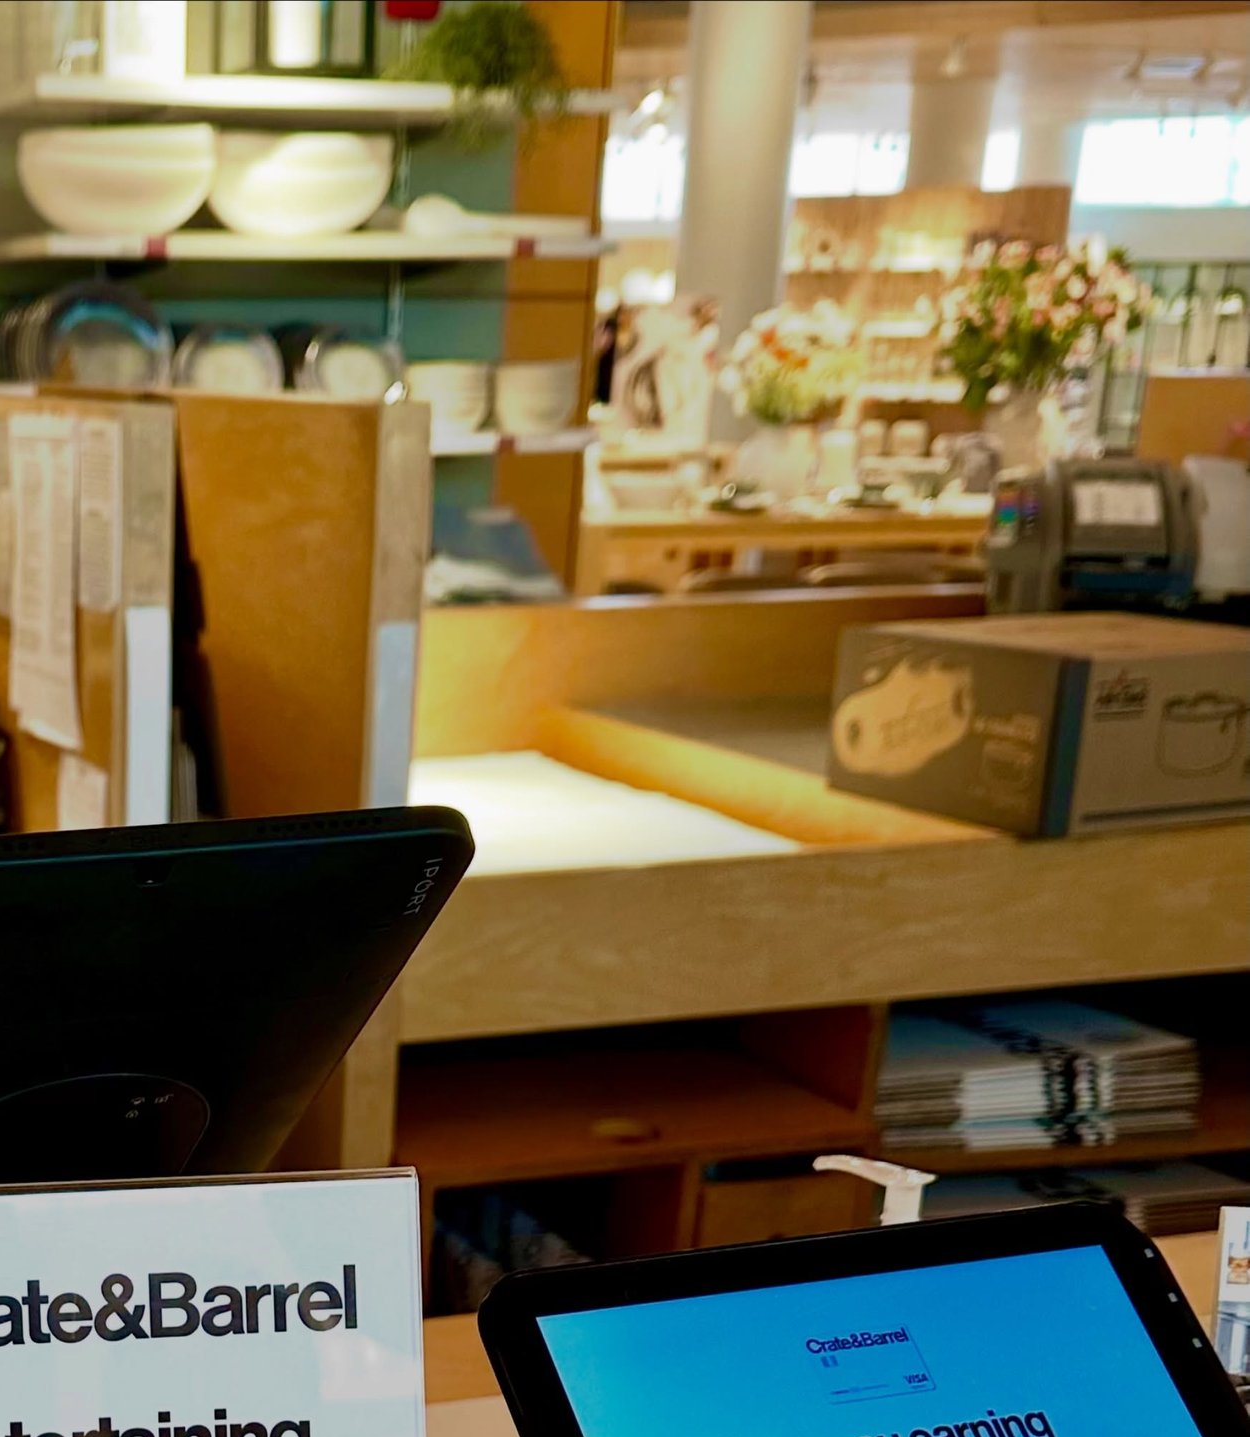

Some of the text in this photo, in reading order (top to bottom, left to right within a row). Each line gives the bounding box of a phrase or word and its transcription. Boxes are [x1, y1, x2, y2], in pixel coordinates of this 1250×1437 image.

[403, 858, 443, 915] IPORT
[806, 1327, 909, 1354] Crate&Barrel
[903, 1373, 929, 1385] VISA
